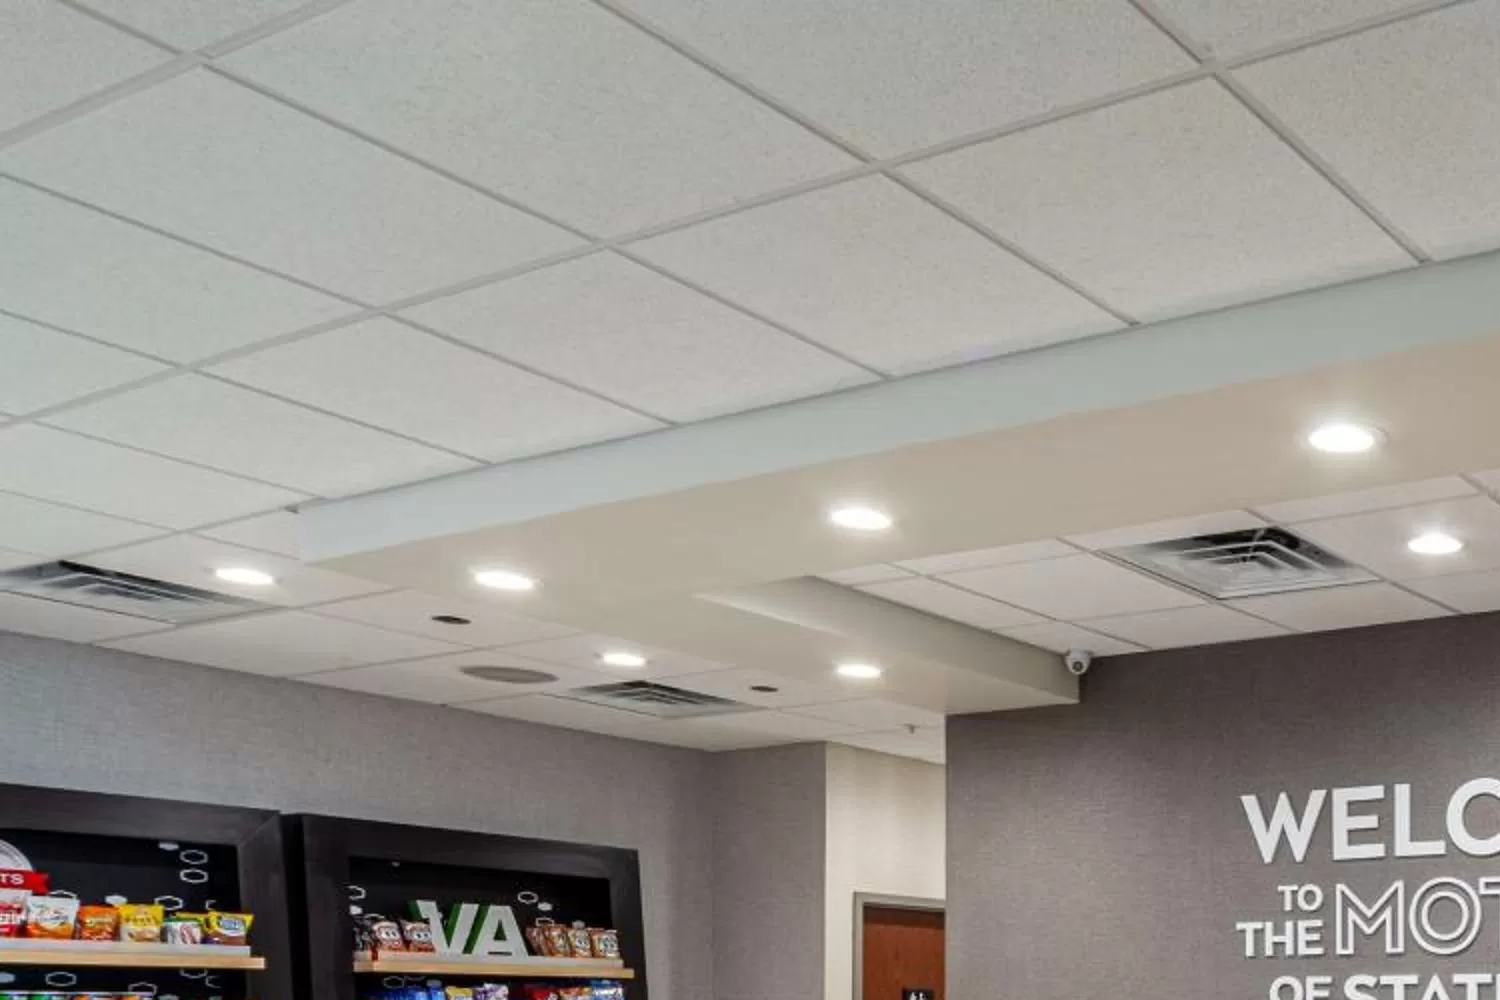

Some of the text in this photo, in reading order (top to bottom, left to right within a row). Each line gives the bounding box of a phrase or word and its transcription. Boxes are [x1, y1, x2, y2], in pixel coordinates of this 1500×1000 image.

[1277, 884, 1324, 912] TO
[410, 900, 529, 958] VA
[1236, 919, 1325, 957] THE
